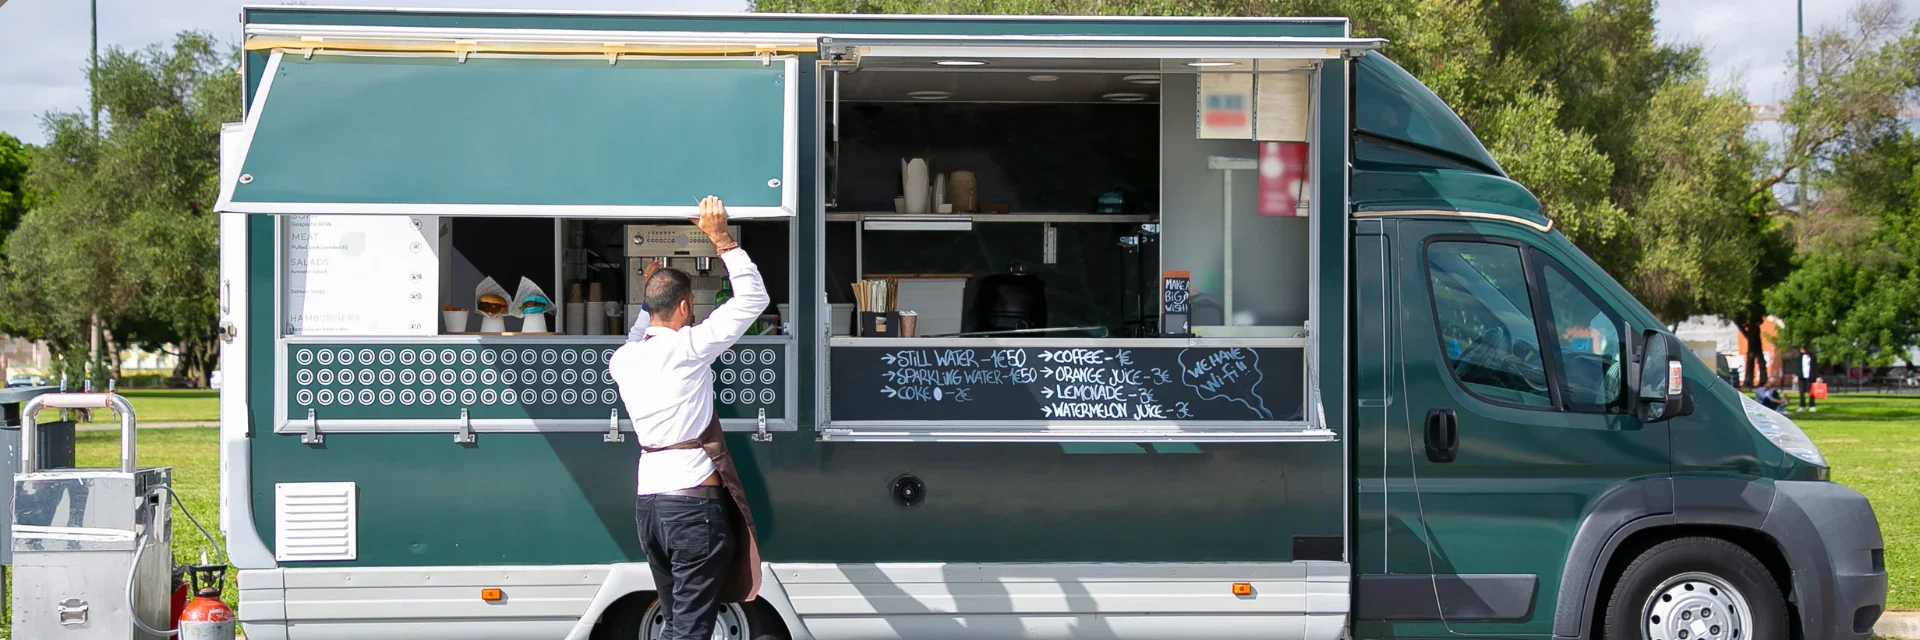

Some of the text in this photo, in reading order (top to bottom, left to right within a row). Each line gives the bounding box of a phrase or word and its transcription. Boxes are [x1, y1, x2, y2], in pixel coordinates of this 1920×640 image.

[291, 232, 319, 241] MEAT
[290, 258, 329, 266] SALADS
[1165, 278, 1185, 290] MAKE
[290, 314, 360, 322] HAMBURGERS
[933, 349, 979, 368] WATER
[1053, 348, 1104, 365] COFFEE
[1208, 347, 1246, 367] HAVE
[964, 369, 1003, 385] WATER
[1055, 366, 1106, 384] ORANGE
[897, 385, 932, 402] COKE
[1056, 384, 1127, 402] LEMONADE
[1052, 402, 1128, 419] WATERMELON
